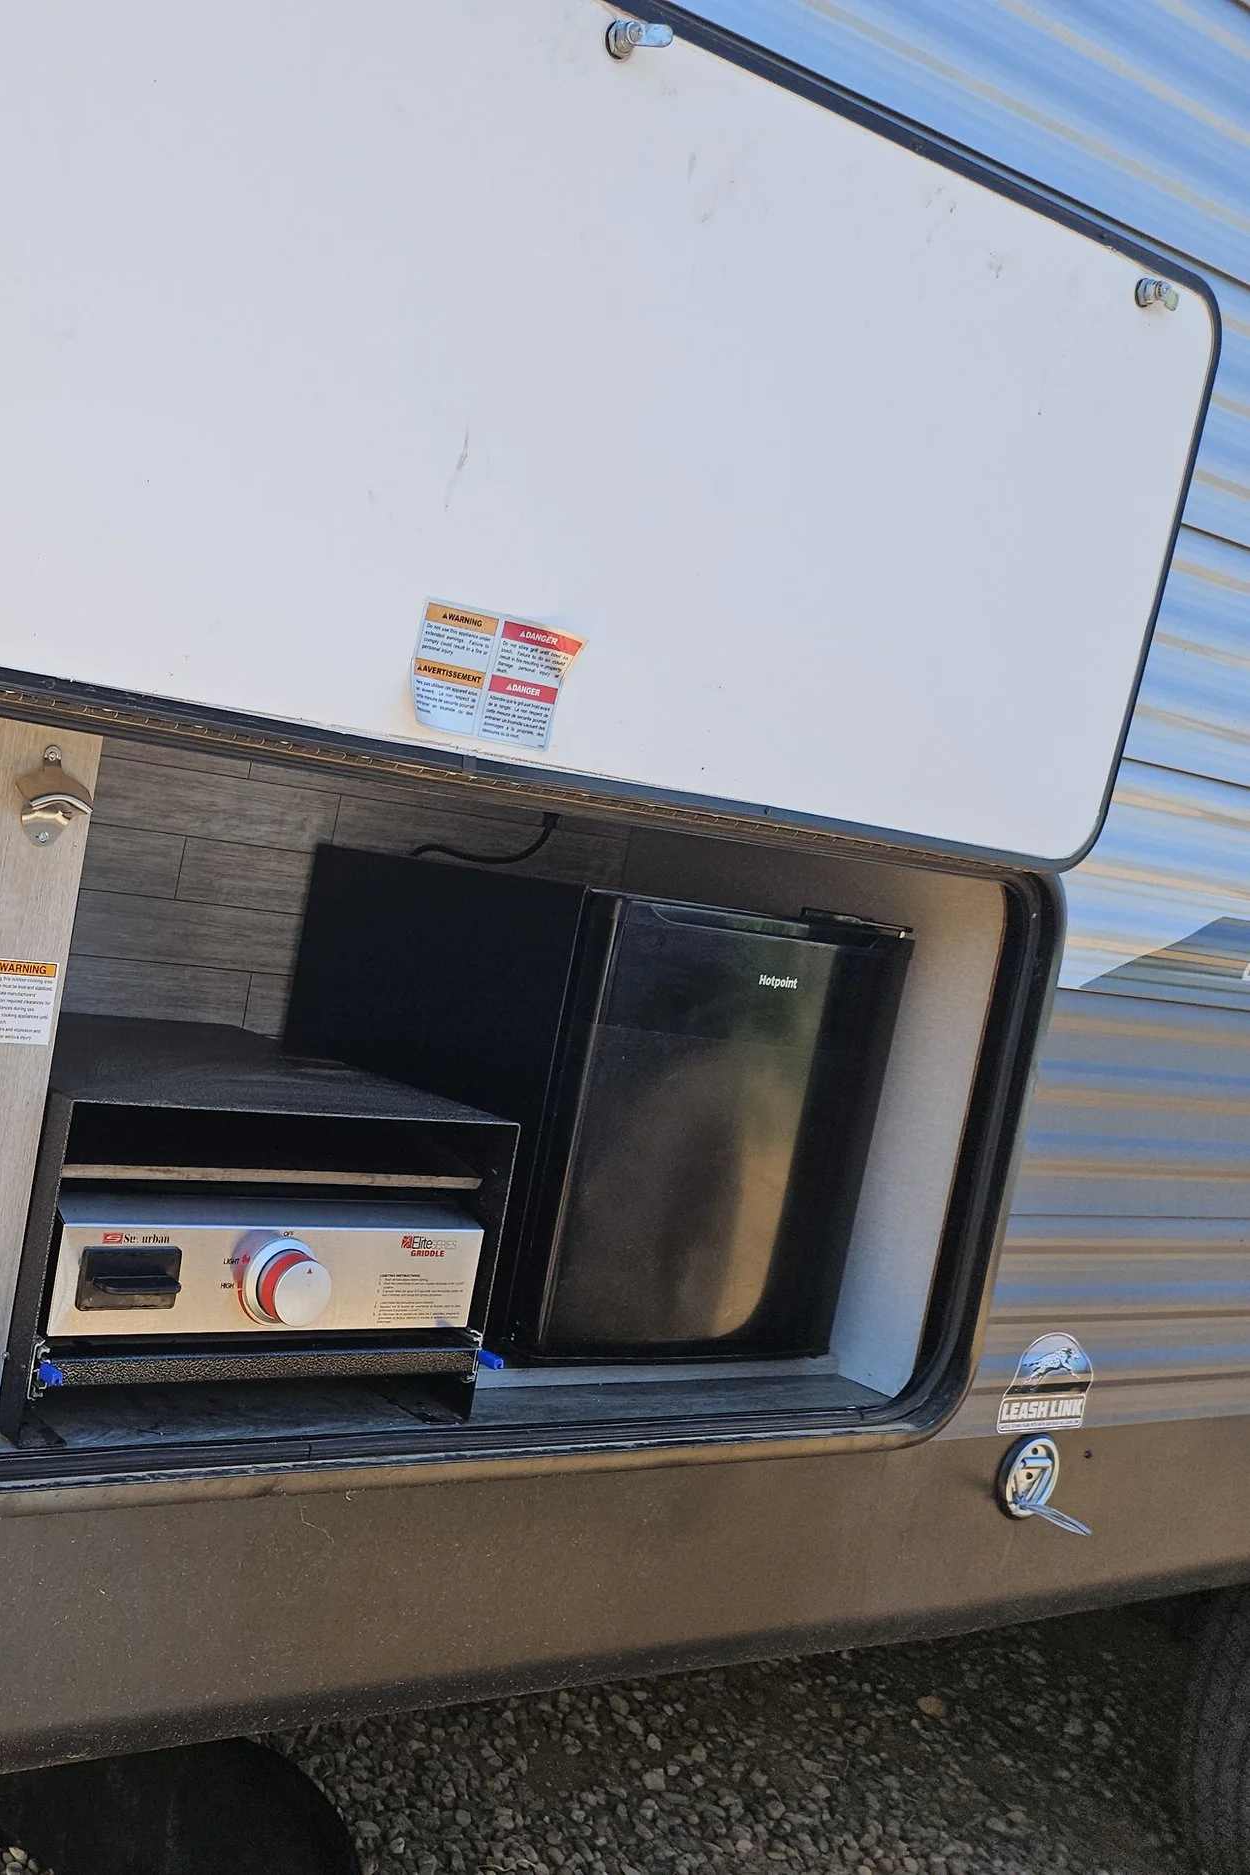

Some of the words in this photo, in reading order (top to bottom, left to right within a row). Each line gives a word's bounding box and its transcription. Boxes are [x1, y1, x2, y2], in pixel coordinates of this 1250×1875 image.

[450, 614, 482, 627] WARNING
[526, 632, 559, 645] DANGER
[422, 665, 482, 683] AVERTISSEMENT
[540, 669, 551, 677] injury
[512, 684, 541, 697] DANGER
[0, 963, 47, 974] WARNING
[759, 974, 798, 989] Hotpoint
[1001, 1401, 1049, 1420] LEASH
[1049, 1399, 1083, 1417] LINK
